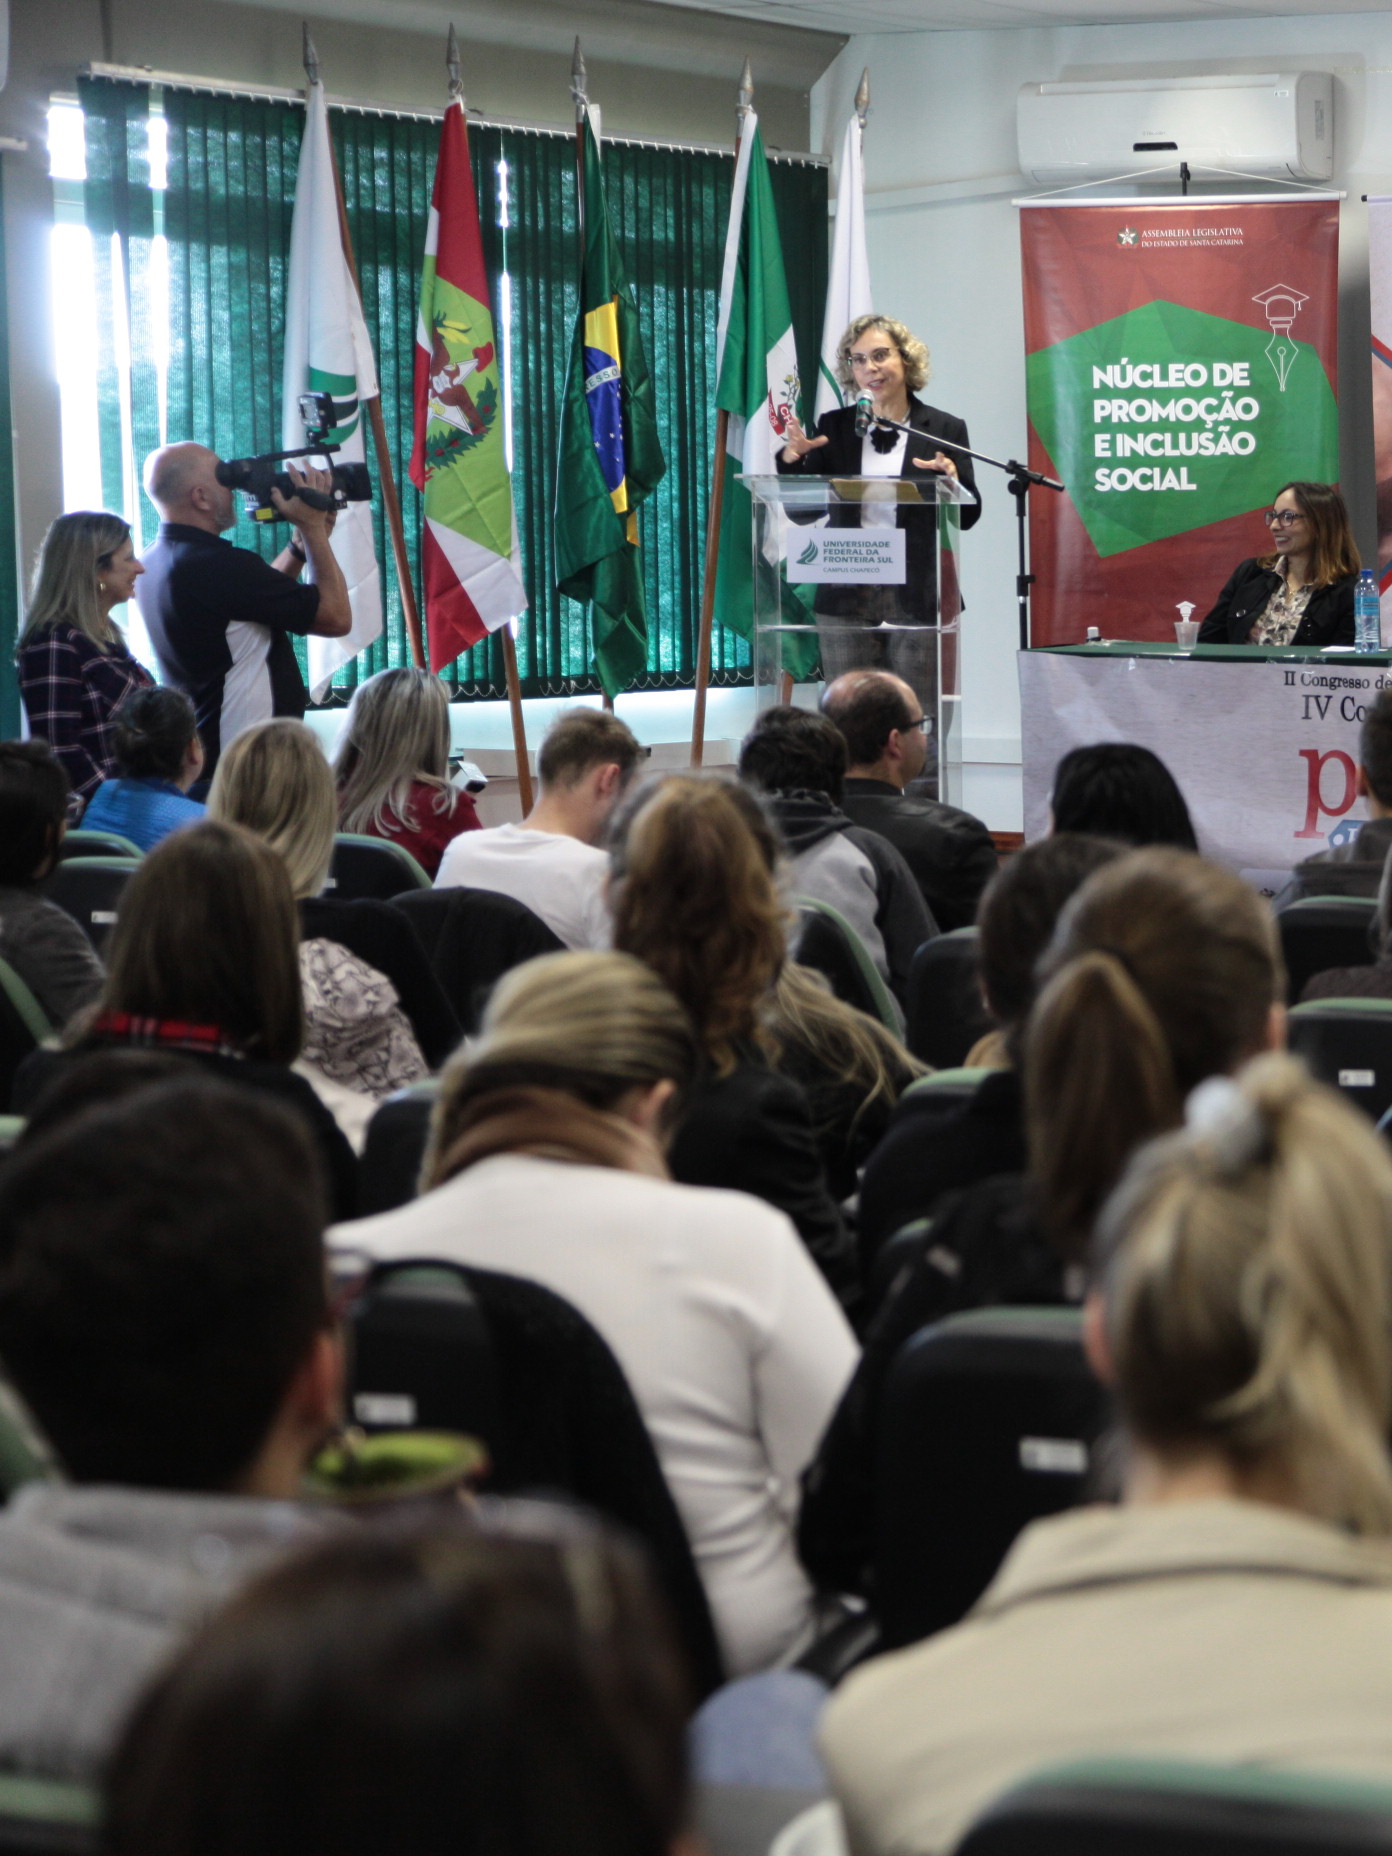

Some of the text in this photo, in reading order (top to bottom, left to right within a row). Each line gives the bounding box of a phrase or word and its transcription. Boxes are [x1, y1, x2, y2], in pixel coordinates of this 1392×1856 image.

[1141, 228, 1243, 238] ASSEMBLEIA LEGISLATIVA
[1141, 240, 1152, 248] DO
[1153, 239, 1179, 247] ESTADO
[1180, 239, 1188, 247] DE
[1211, 238, 1243, 246] CATARINA
[1092, 357, 1250, 389] NÚCLEO DE
[1093, 390, 1259, 428] PROMOÇÃO
[1094, 425, 1256, 457] E INCLUSÃO
[1094, 466, 1197, 491] SOCIAL
[1284, 671, 1296, 685] II
[1301, 672, 1370, 690] Congresso
[1375, 675, 1392, 690] de
[1302, 695, 1333, 720] IV
